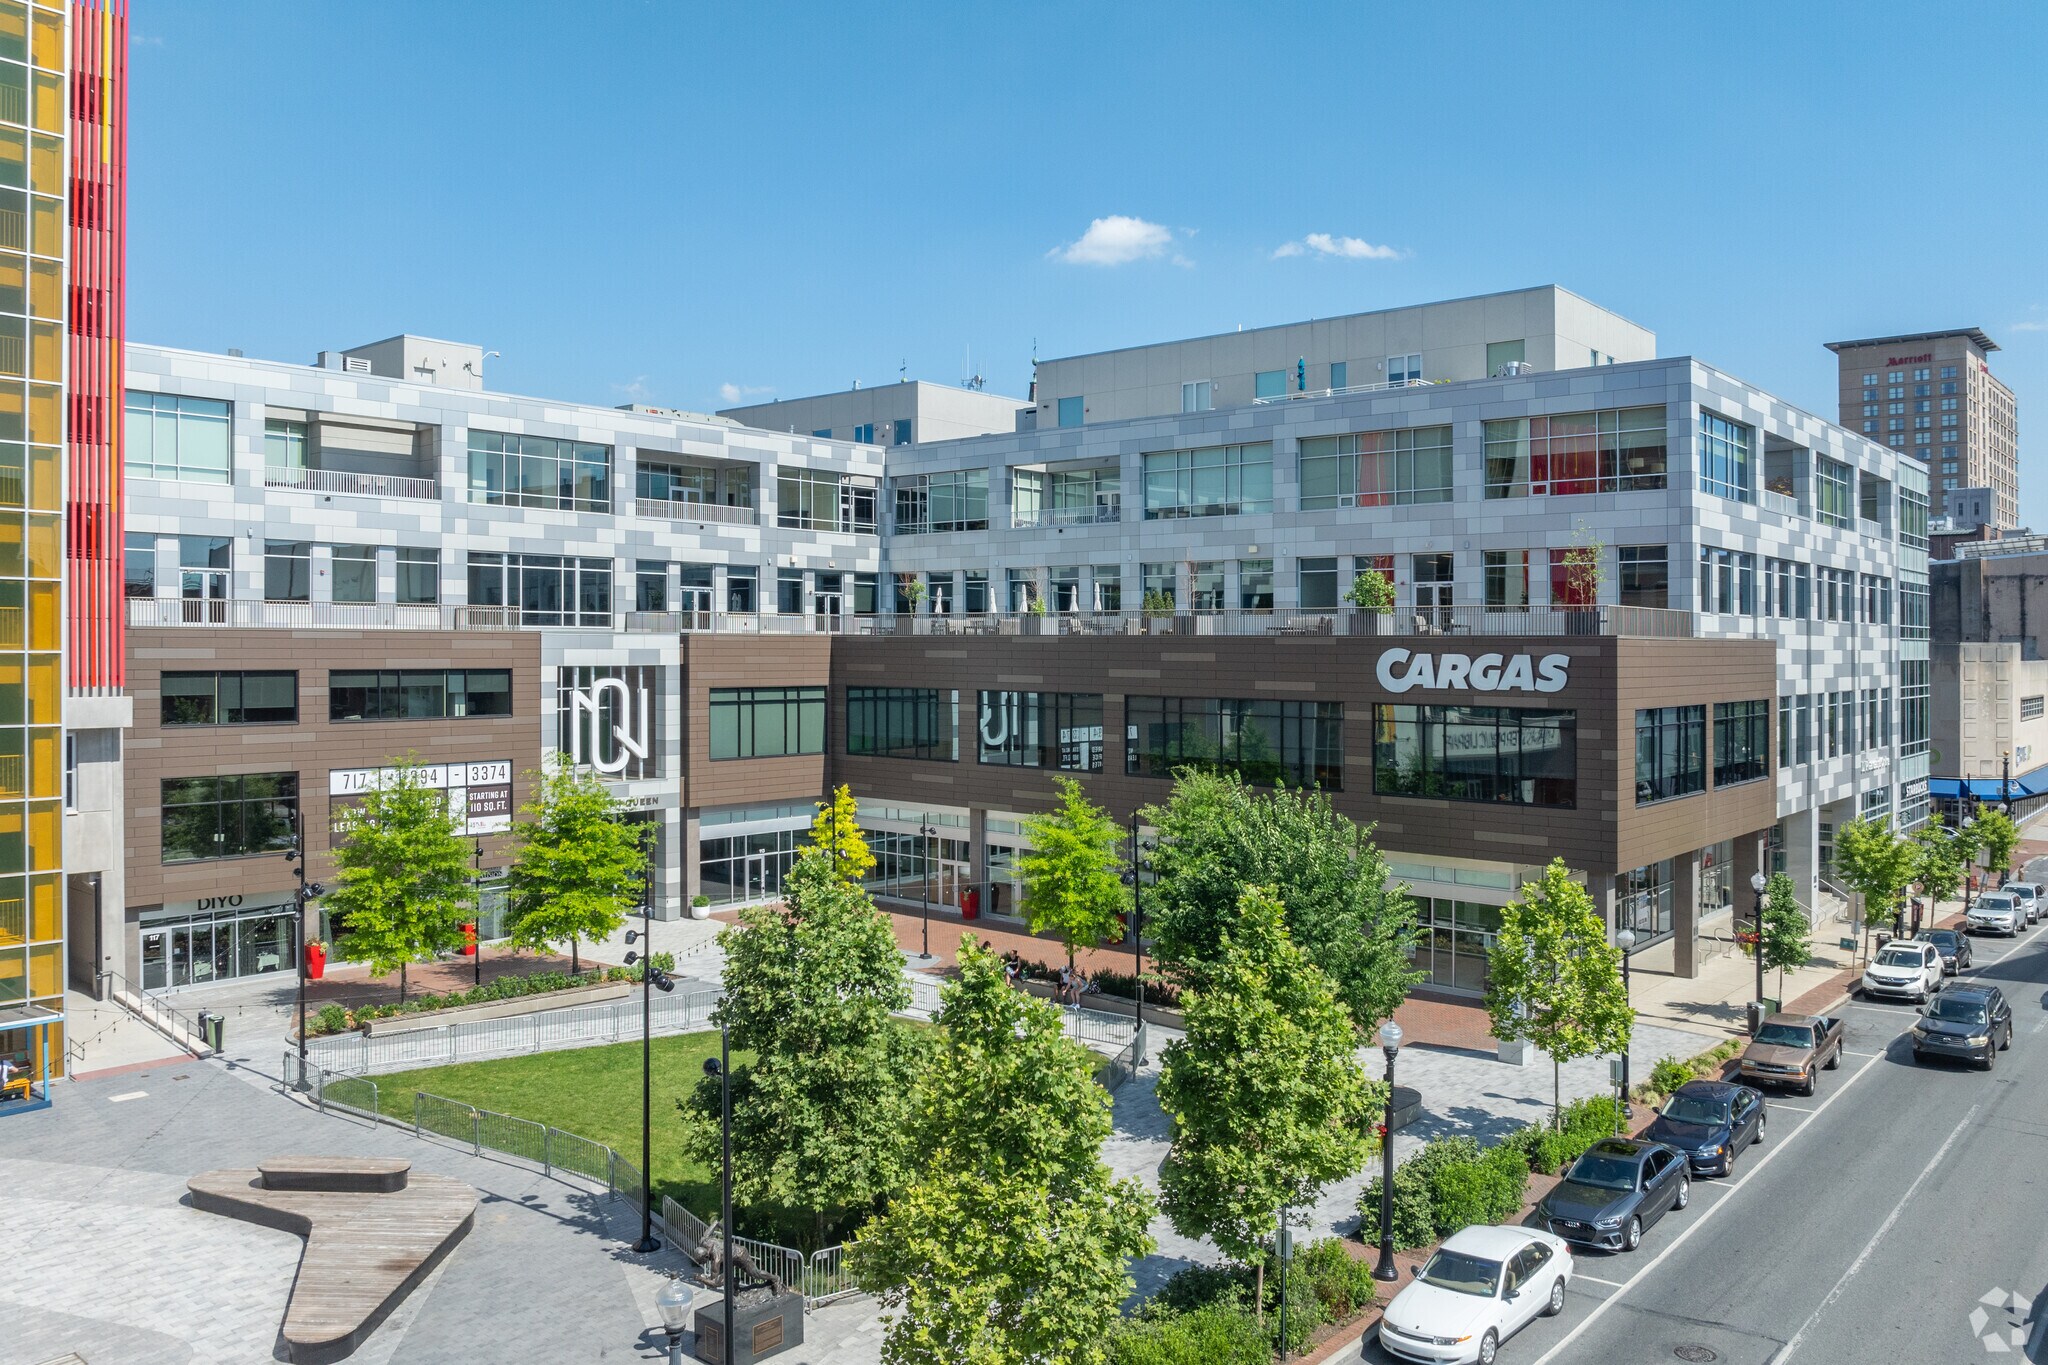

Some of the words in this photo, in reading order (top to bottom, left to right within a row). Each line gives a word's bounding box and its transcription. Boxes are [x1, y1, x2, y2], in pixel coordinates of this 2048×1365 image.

[1376, 647, 1570, 694] CARGAS
[343, 773, 366, 789] 717
[472, 765, 506, 781] 3374
[469, 791, 499, 801] STARTING
[499, 790, 509, 799] AT
[333, 819, 376, 834] LEASG
[197, 894, 243, 911] DIYO
